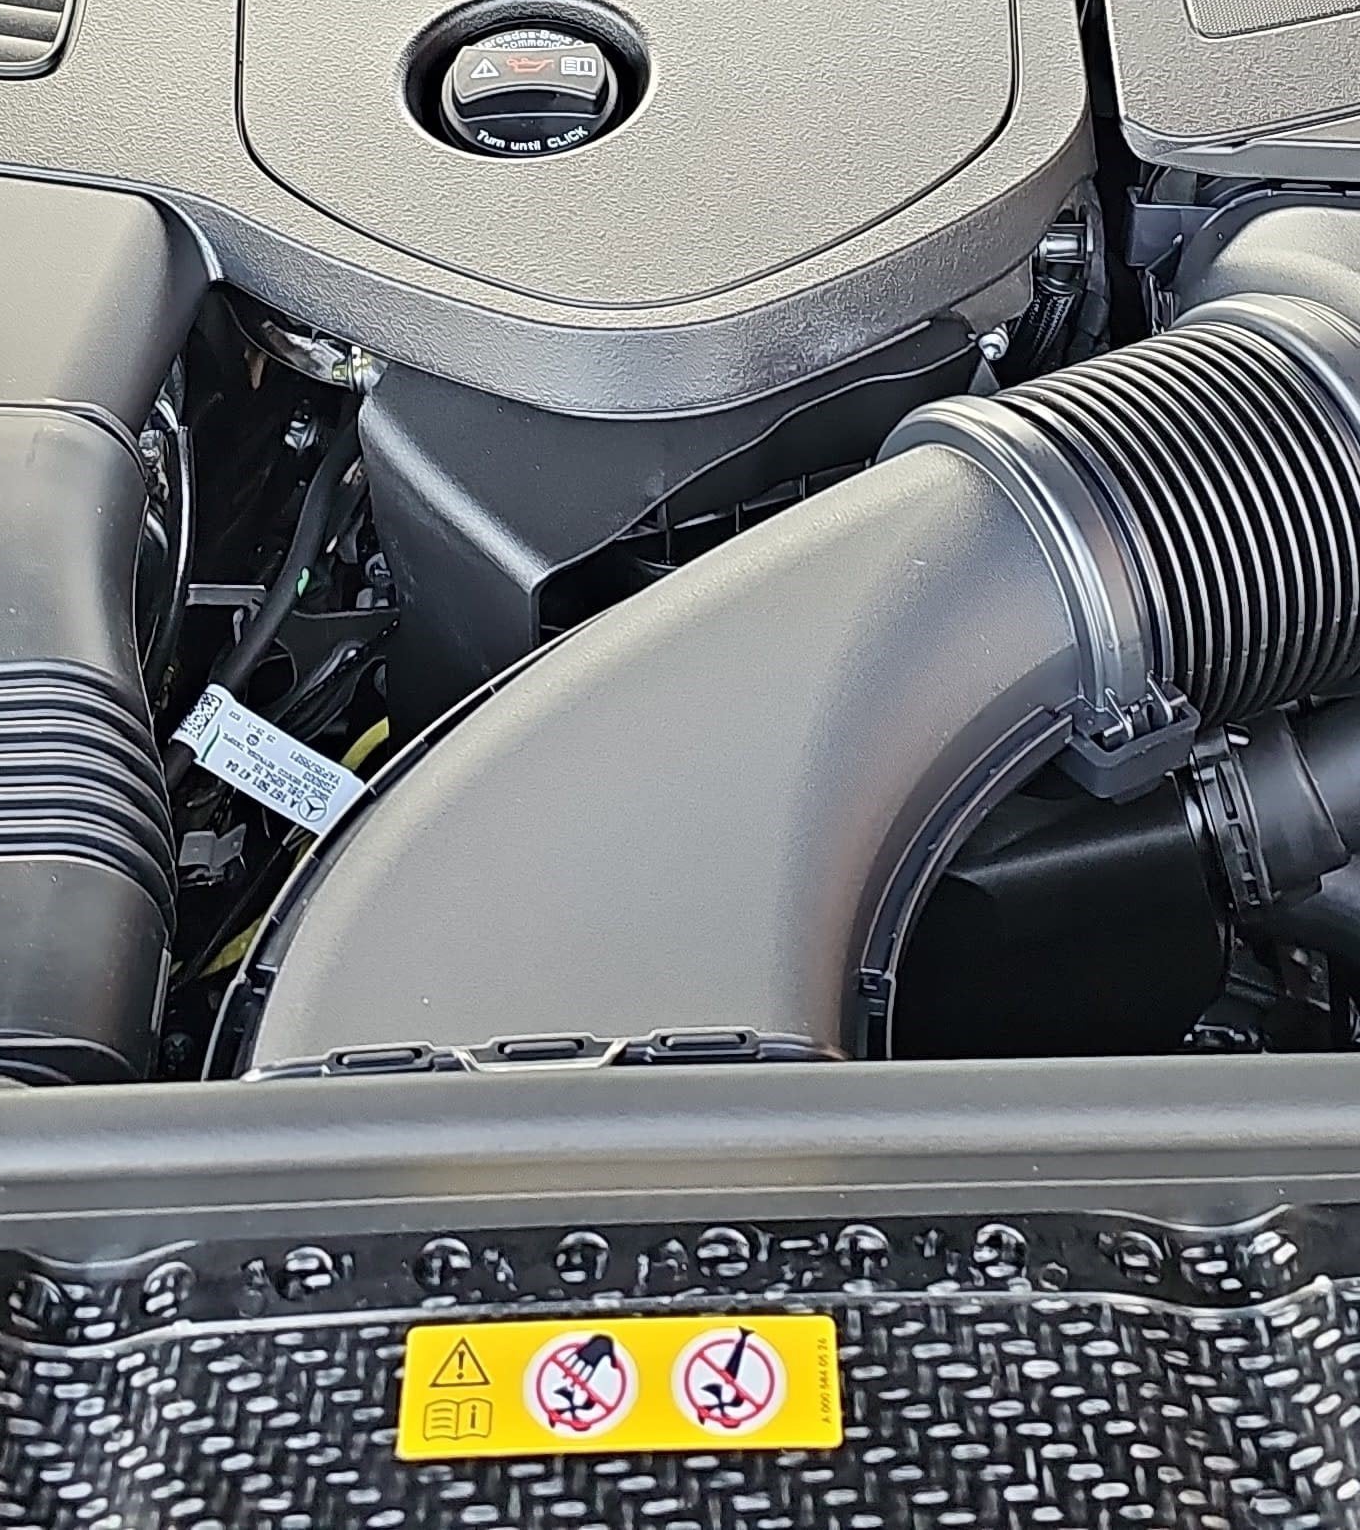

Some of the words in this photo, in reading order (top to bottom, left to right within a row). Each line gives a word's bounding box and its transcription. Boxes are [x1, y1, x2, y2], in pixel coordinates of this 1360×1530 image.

[476, 129, 506, 149] Turn
[510, 140, 542, 151] until
[546, 125, 589, 149] CLICK
[289, 797, 297, 807] A
